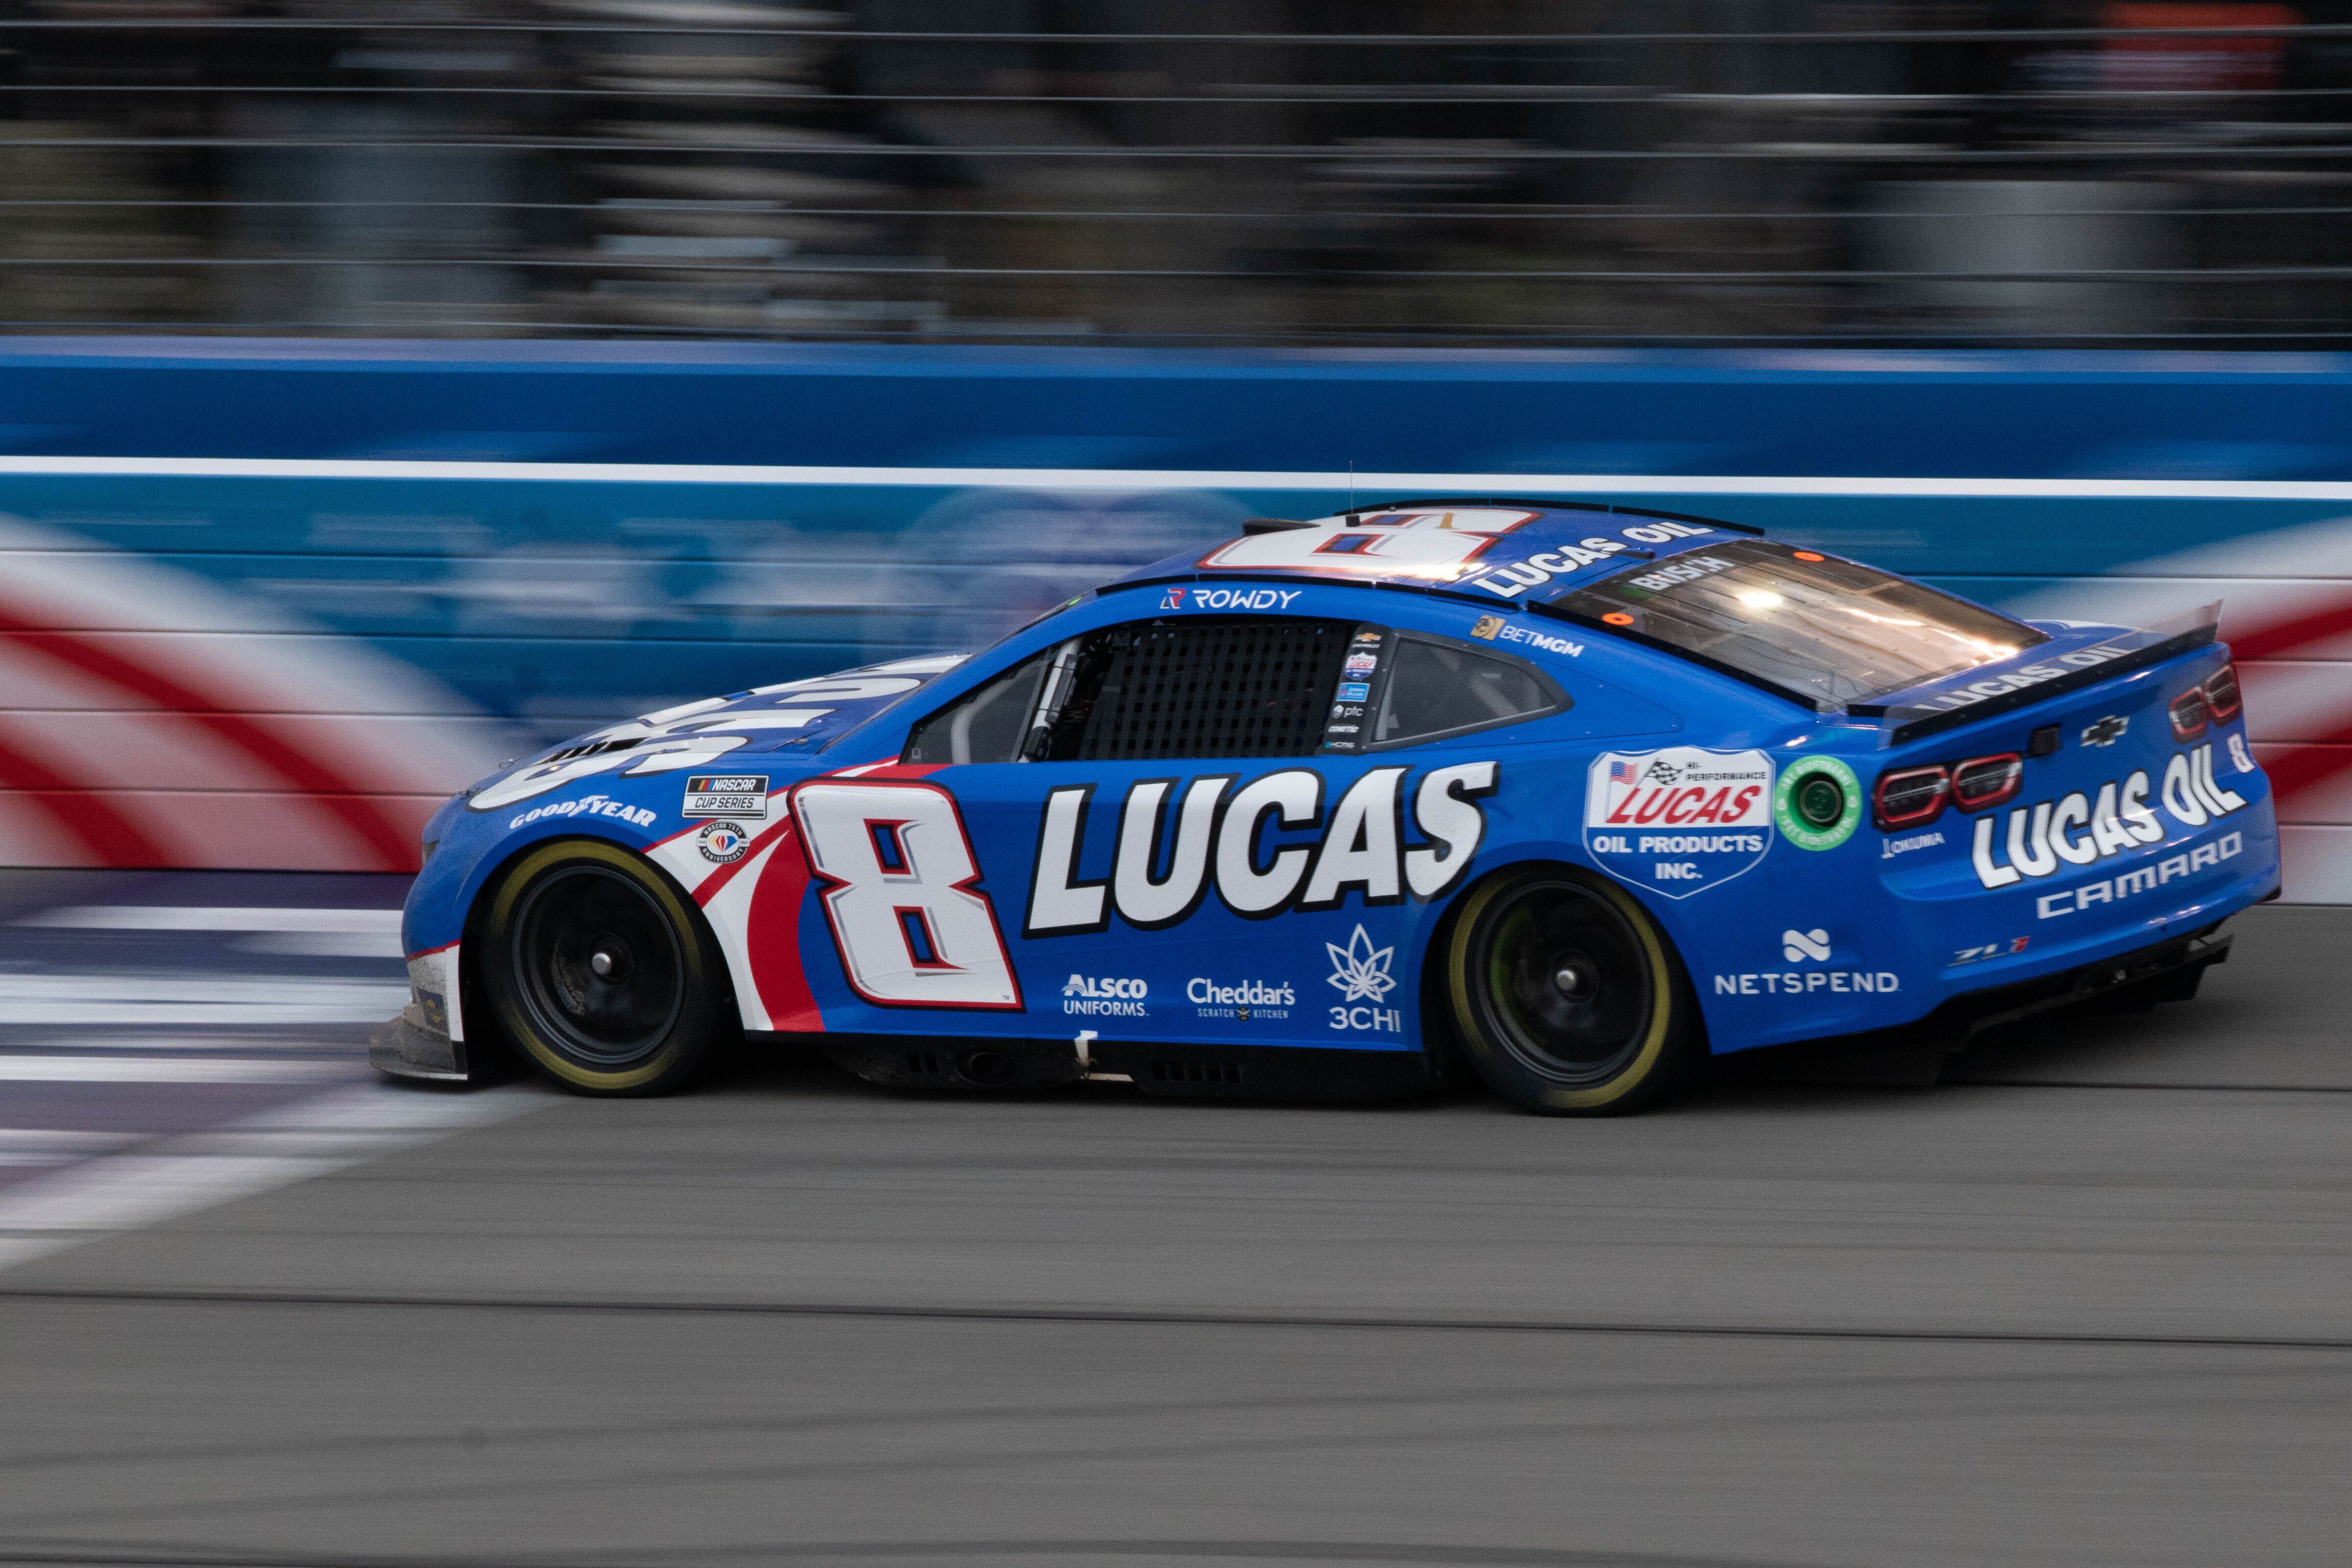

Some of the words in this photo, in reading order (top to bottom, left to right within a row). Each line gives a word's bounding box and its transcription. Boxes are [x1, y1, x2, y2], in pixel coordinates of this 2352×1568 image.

[1472, 537, 1628, 598] LUCAS
[1622, 521, 1715, 543] OIL
[1192, 590, 1303, 609] ROWDY
[1499, 625, 1584, 657] BETMGM
[1343, 705, 1363, 718] ptc
[2227, 733, 2255, 773] 8
[712, 779, 756, 791] NASCAR
[1686, 772, 1767, 781] PERFORMANCE
[509, 795, 656, 827] GOODYEAR
[695, 797, 717, 808] CUP
[717, 797, 754, 808] SERIES
[1605, 785, 1762, 824] LUCAS
[1972, 770, 2164, 889] LUCAS
[2162, 744, 2248, 826] OIL
[703, 823, 727, 835] NASCAR
[728, 823, 742, 835] 75TH
[703, 848, 744, 862] ANNIVERSARY
[1025, 761, 1500, 935] LUCAS
[1593, 836, 1632, 853] OIL
[1639, 835, 1763, 853] PRODUCTS
[1655, 863, 1703, 879] INC.
[2036, 831, 2242, 920] CAMARO
[789, 778, 1026, 1011] 8
[1061, 974, 1147, 999] ALSCO
[1187, 978, 1295, 1005] Cheddar's
[1715, 972, 1899, 994] NETSPEND
[1063, 1000, 1145, 1016] UNIFORMS
[1198, 1008, 1234, 1017] SCRATCH
[1253, 1010, 1288, 1018] KITCHEN
[1329, 1007, 1401, 1032] 3CHI
